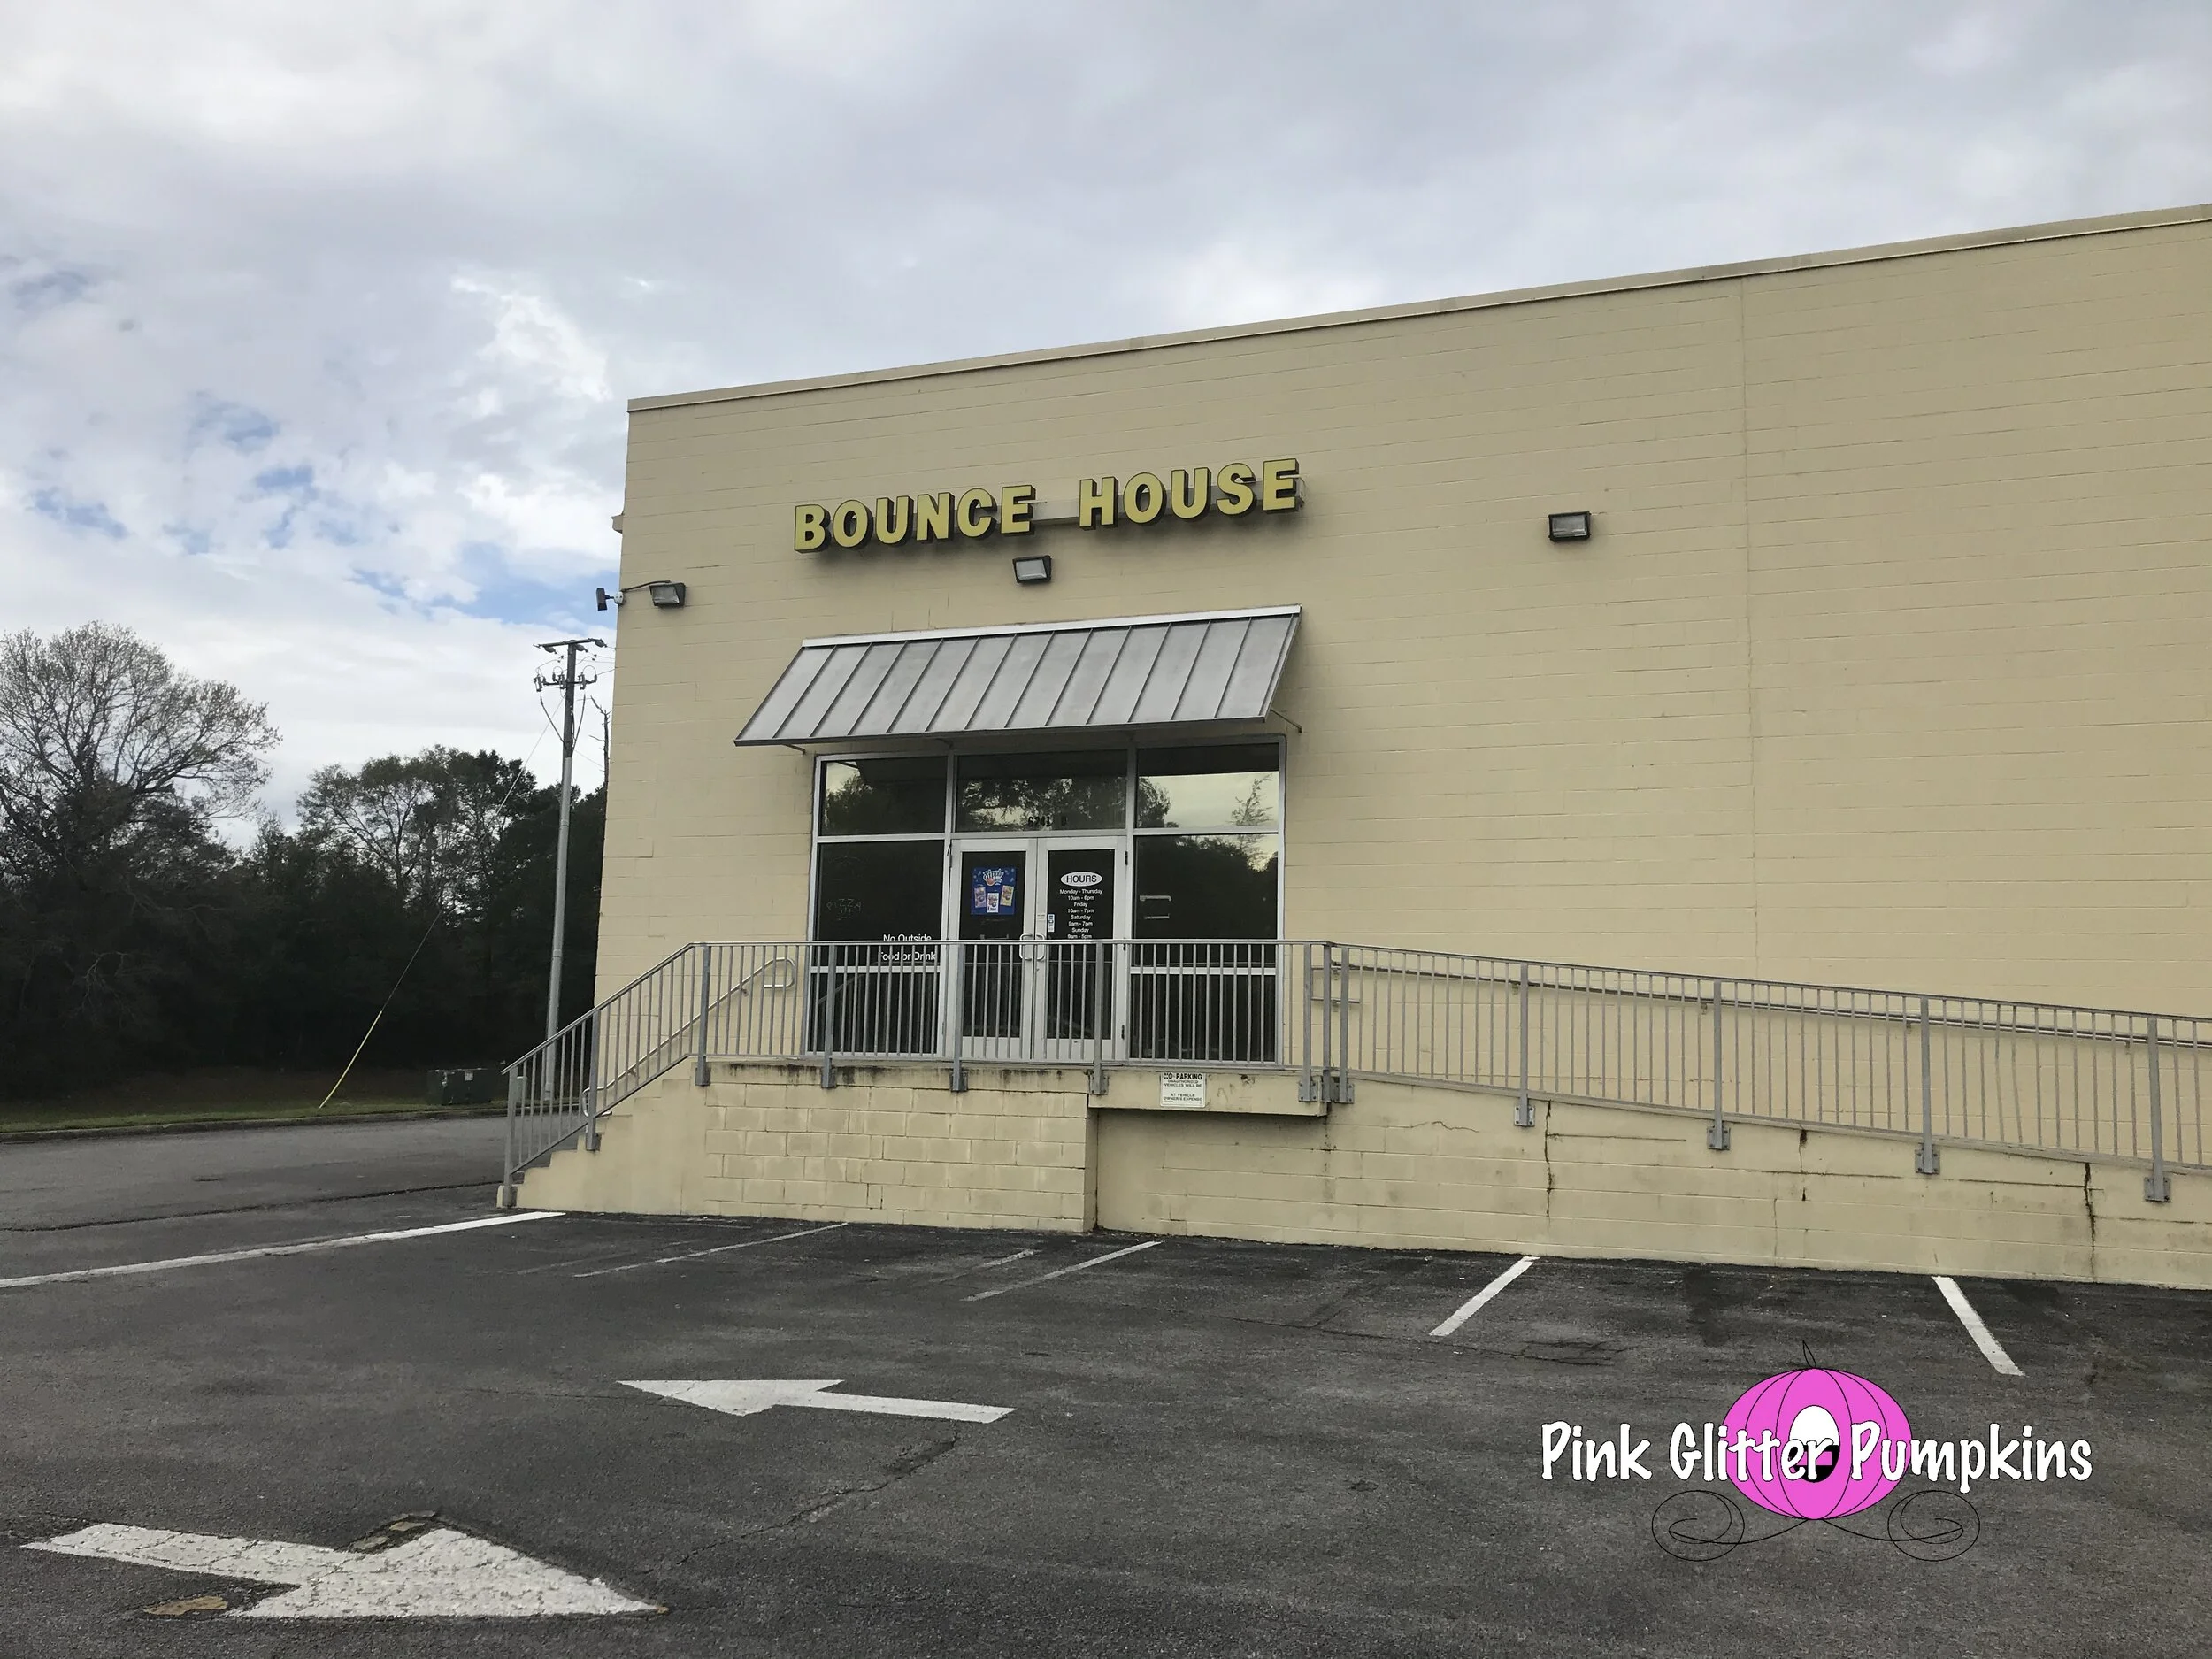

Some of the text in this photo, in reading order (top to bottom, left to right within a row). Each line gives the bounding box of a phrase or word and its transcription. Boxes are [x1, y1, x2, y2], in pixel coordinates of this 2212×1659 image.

[795, 457, 1306, 553] BOUNCE HOUSE
[913, 951, 936, 961] Drnk
